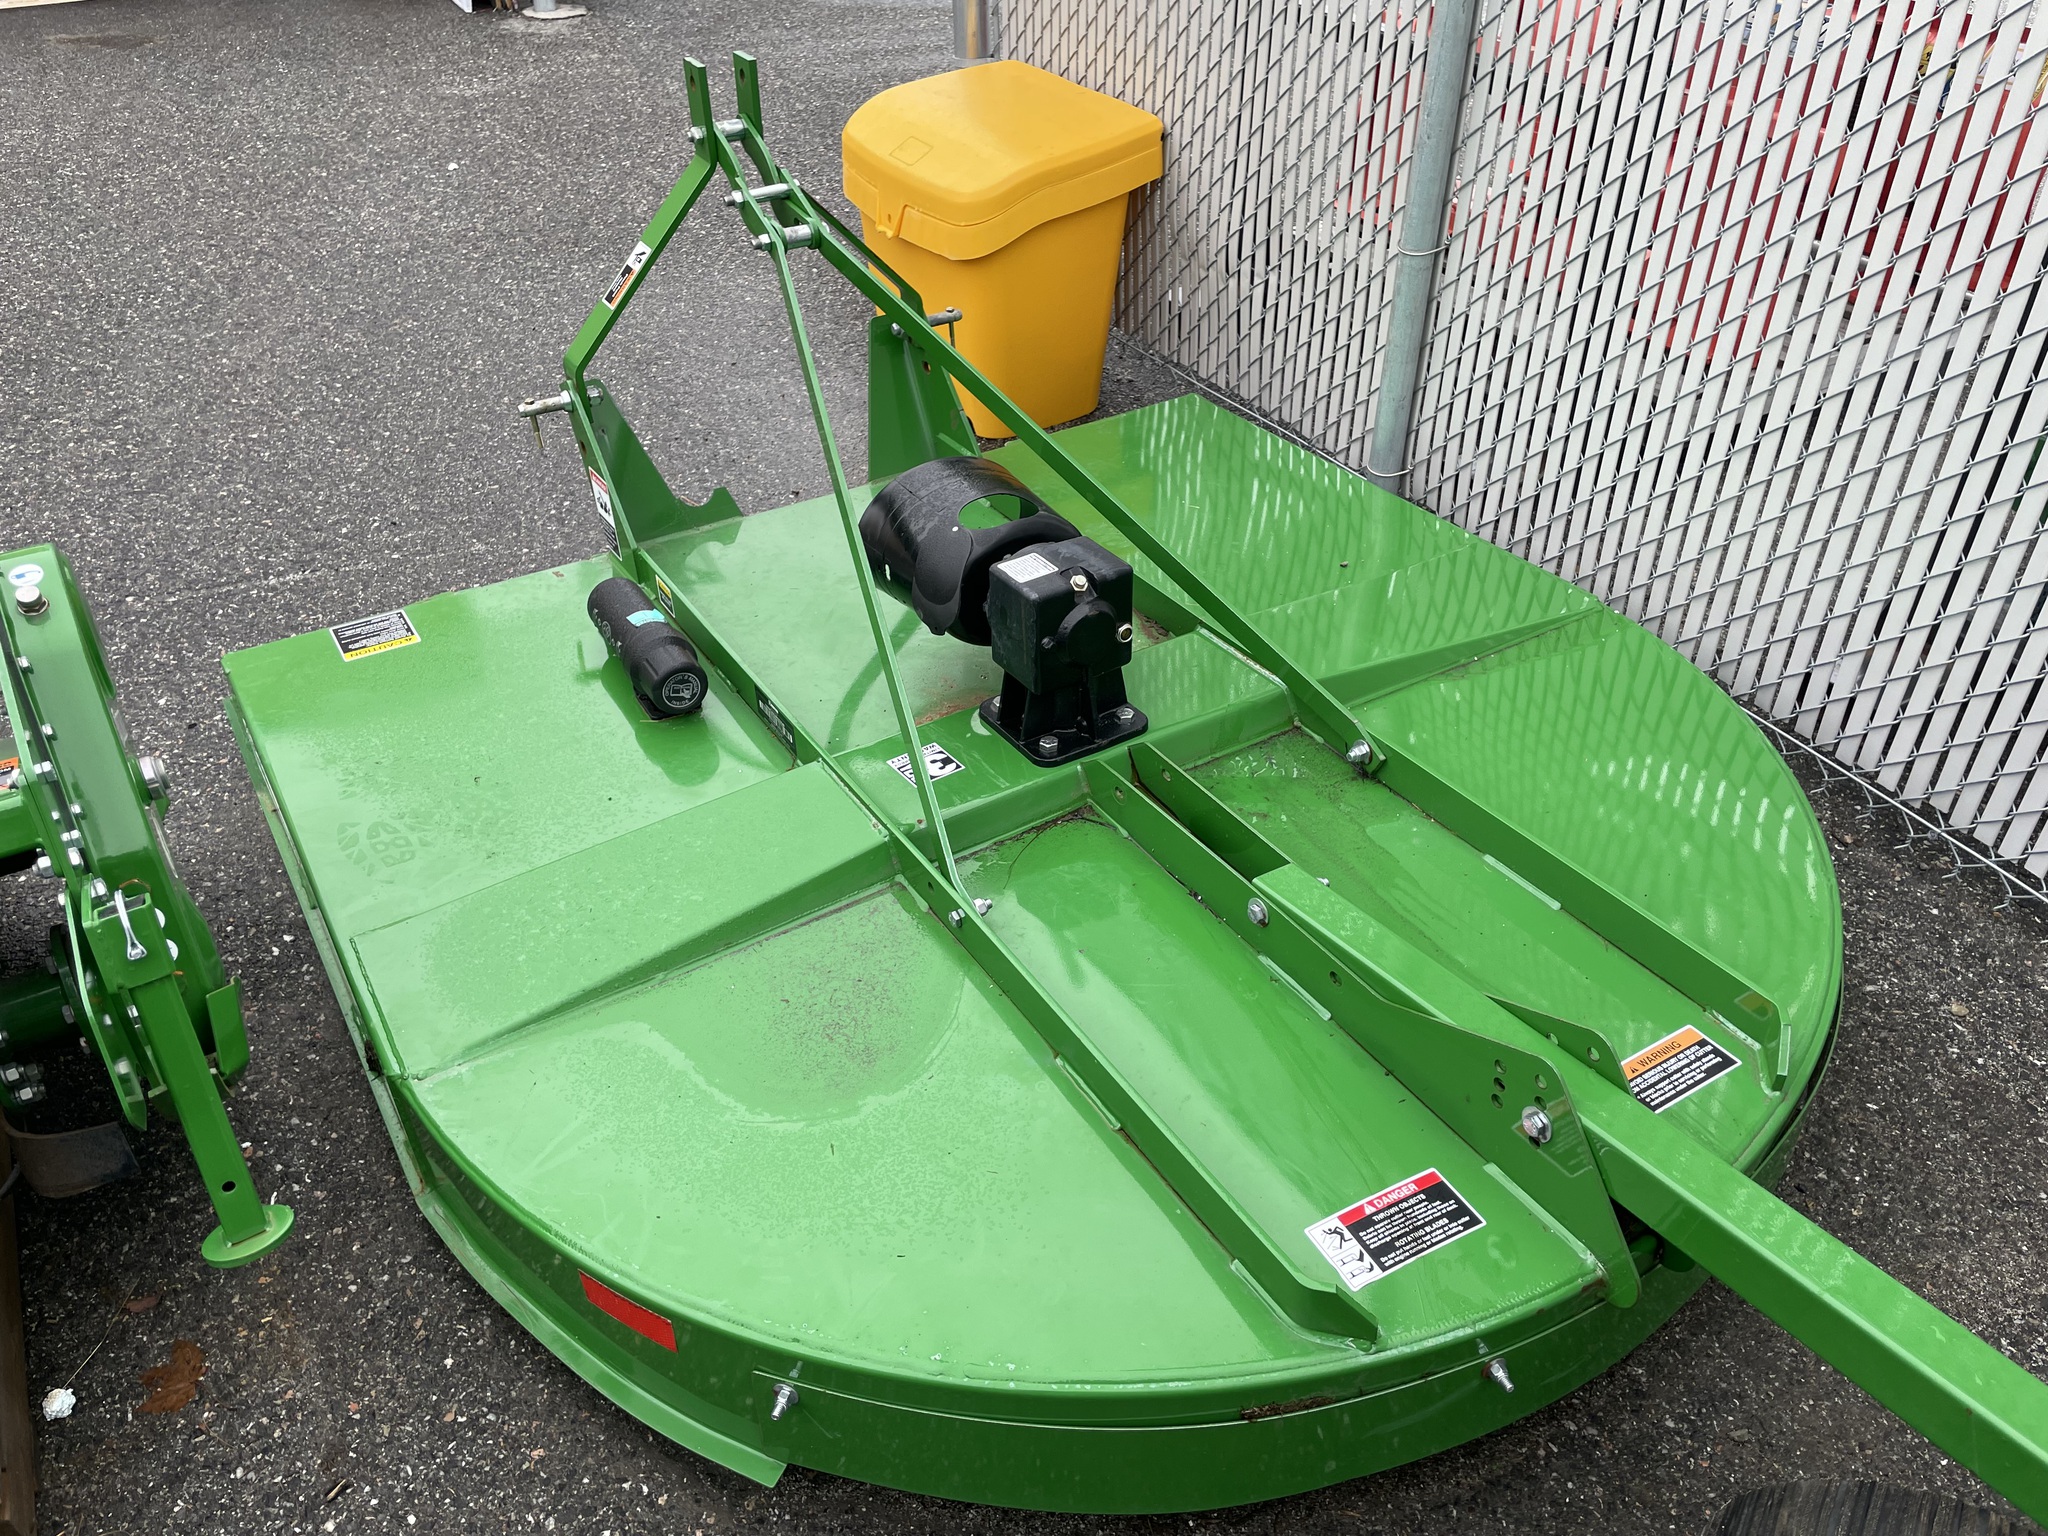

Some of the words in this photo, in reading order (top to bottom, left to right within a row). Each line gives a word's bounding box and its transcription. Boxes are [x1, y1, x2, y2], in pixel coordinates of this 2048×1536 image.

[350, 641, 402, 657] CAUTION
[665, 675, 688, 696] OPERATOR'S
[689, 677, 697, 694] MANUAL
[1637, 1040, 1682, 1068] WARNING
[1642, 1066, 1663, 1079] SERIOUS
[1661, 1057, 1678, 1068] INJURY
[1684, 1045, 1700, 1056] DEATH
[1638, 1071, 1668, 1089] ACCIDENTAL
[1665, 1058, 1690, 1073] LOWERING
[1640, 1088, 1656, 1098] Always
[1655, 1078, 1671, 1089] support
[1670, 1072, 1682, 1081] cutter
[1690, 1061, 1703, 1069] safety
[1701, 1054, 1715, 1063] stands
[1650, 1090, 1664, 1099] blocks
[1678, 1071, 1697, 1083] servicing
[1700, 1057, 1722, 1071] performing
[1650, 1090, 1676, 1106] maintenance
[1675, 1083, 1687, 1091] under
[1372, 1206, 1399, 1221] THROWN
[1399, 1194, 1426, 1209] OBJECTS
[1374, 1183, 1418, 1208] DANGER
[1362, 1232, 1378, 1240] Debris
[1392, 1217, 1407, 1226] thrown
[1407, 1206, 1427, 1218] hundreds
[1374, 1219, 1390, 1229] operate
[1413, 1202, 1429, 1211] people.
[1384, 1226, 1400, 1236] shields
[1417, 1208, 1438, 1219] including
[1370, 1236, 1391, 1249] discharge
[1391, 1228, 1409, 1238] opening
[1394, 1252, 1410, 1261] engine
[1409, 1243, 1427, 1254] running
[1431, 1234, 1446, 1242] blades
[1446, 1226, 1464, 1236] rotating.
[1395, 1229, 1425, 1247] ROTATING
[1424, 1218, 1449, 1232] BLADES
[1403, 1242, 1417, 1250] hands
[1431, 1228, 1444, 1237] under
[1457, 1216, 1470, 1224] cutter
